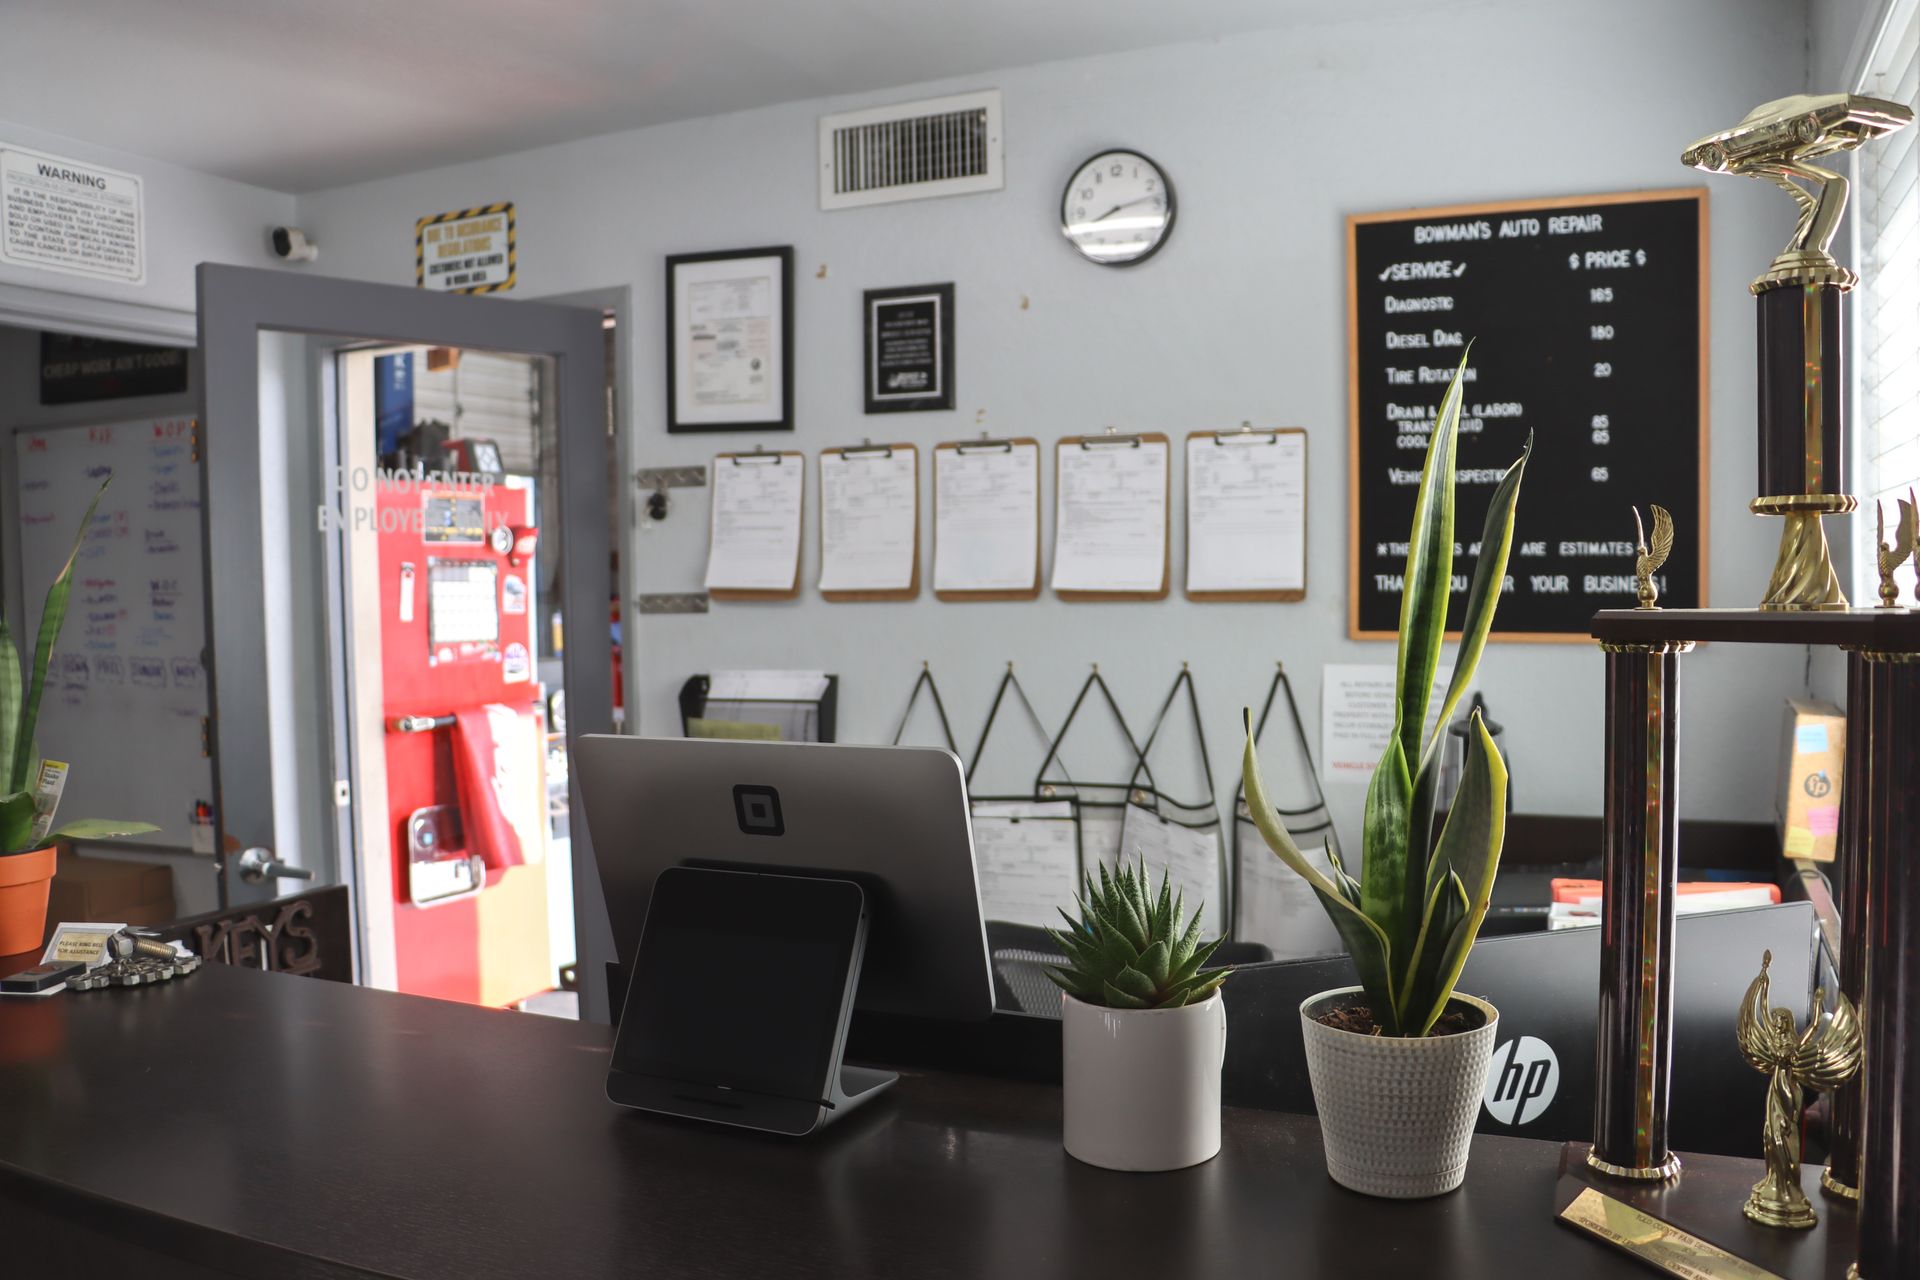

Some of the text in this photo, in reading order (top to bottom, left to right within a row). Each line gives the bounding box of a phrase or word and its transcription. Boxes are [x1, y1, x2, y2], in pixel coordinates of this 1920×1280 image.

[37, 163, 106, 190] WARNING
[1414, 214, 1603, 244] BOWMAN'S AUTO REPAIR
[1569, 248, 1646, 269] $ PRICE $
[1391, 260, 1452, 281] SERVICE
[1418, 366, 1477, 383] ROTATON
[1593, 362, 1612, 378] 20
[378, 467, 421, 495] NOT
[429, 470, 495, 496] ENTER
[1520, 541, 1634, 557] ARE ESTIMATES
[1374, 574, 1404, 592] THA
[1530, 574, 1569, 592] YOUR
[195, 900, 321, 973] KEYS
[1492, 1036, 1551, 1125] hp
